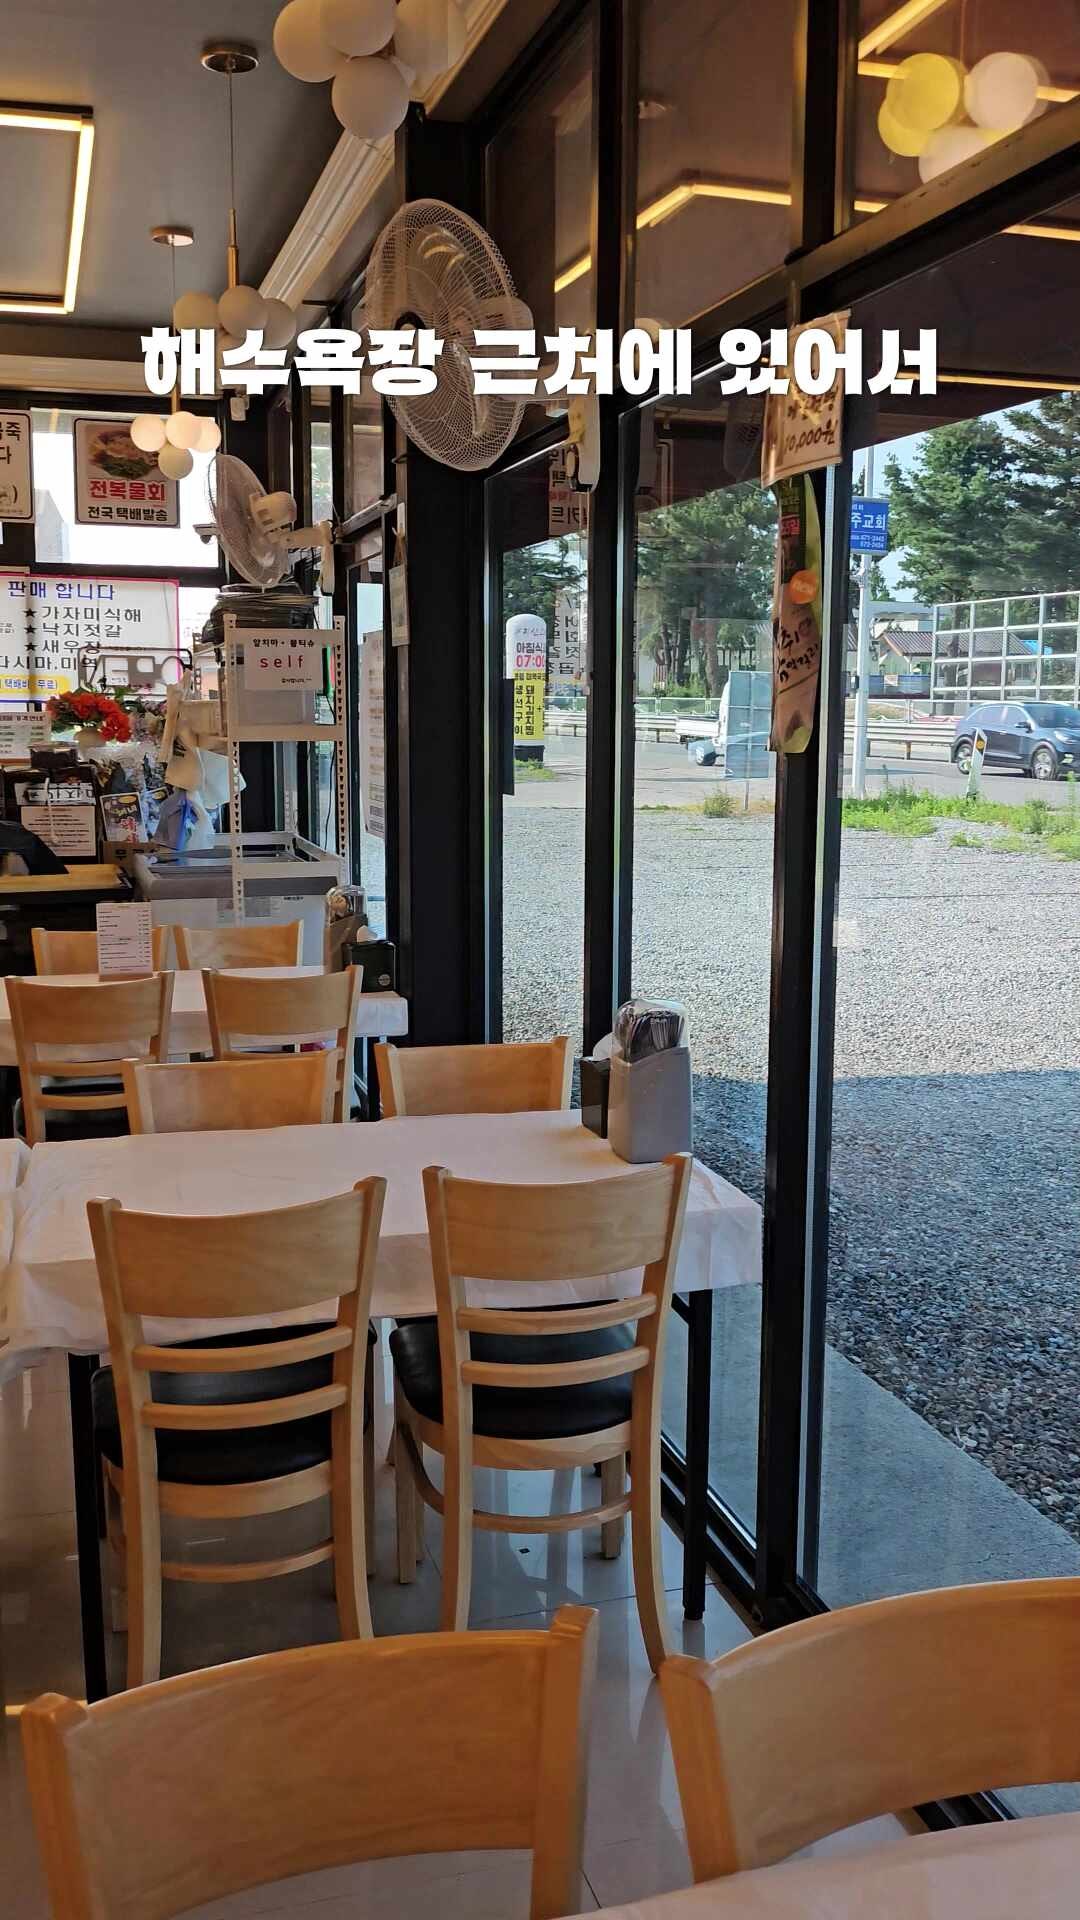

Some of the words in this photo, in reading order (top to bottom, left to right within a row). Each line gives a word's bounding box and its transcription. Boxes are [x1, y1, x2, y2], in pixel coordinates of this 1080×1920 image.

[89, 480, 166, 502] 전복물회
[87, 506, 113, 520] 전국
[116, 507, 169, 522] 택배발송
[851, 512, 886, 531] 주교회
[8, 581, 47, 599] 판매
[56, 583, 115, 600] 합니다
[42, 606, 142, 622] 가자미식해
[42, 622, 123, 638] 낙지젓갈
[42, 639, 101, 654] 새우장
[516, 642, 545, 654] 아침식
[260, 655, 305, 668] self
